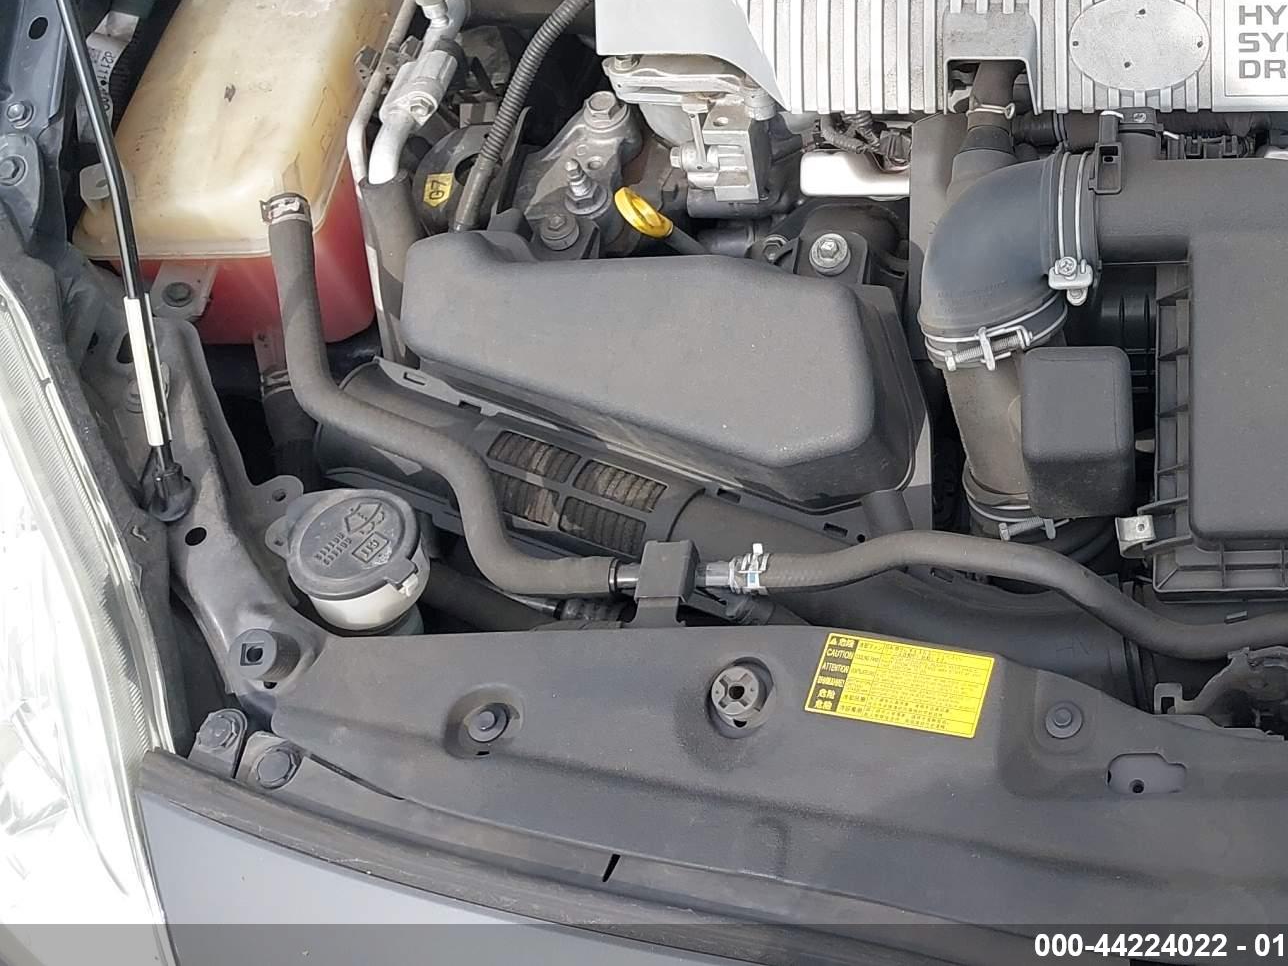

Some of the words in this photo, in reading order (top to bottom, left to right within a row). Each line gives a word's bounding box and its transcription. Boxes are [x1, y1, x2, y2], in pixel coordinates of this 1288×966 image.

[429, 180, 447, 200] G7
[826, 648, 854, 660] CAUTION
[822, 662, 850, 674] ATTENTION
